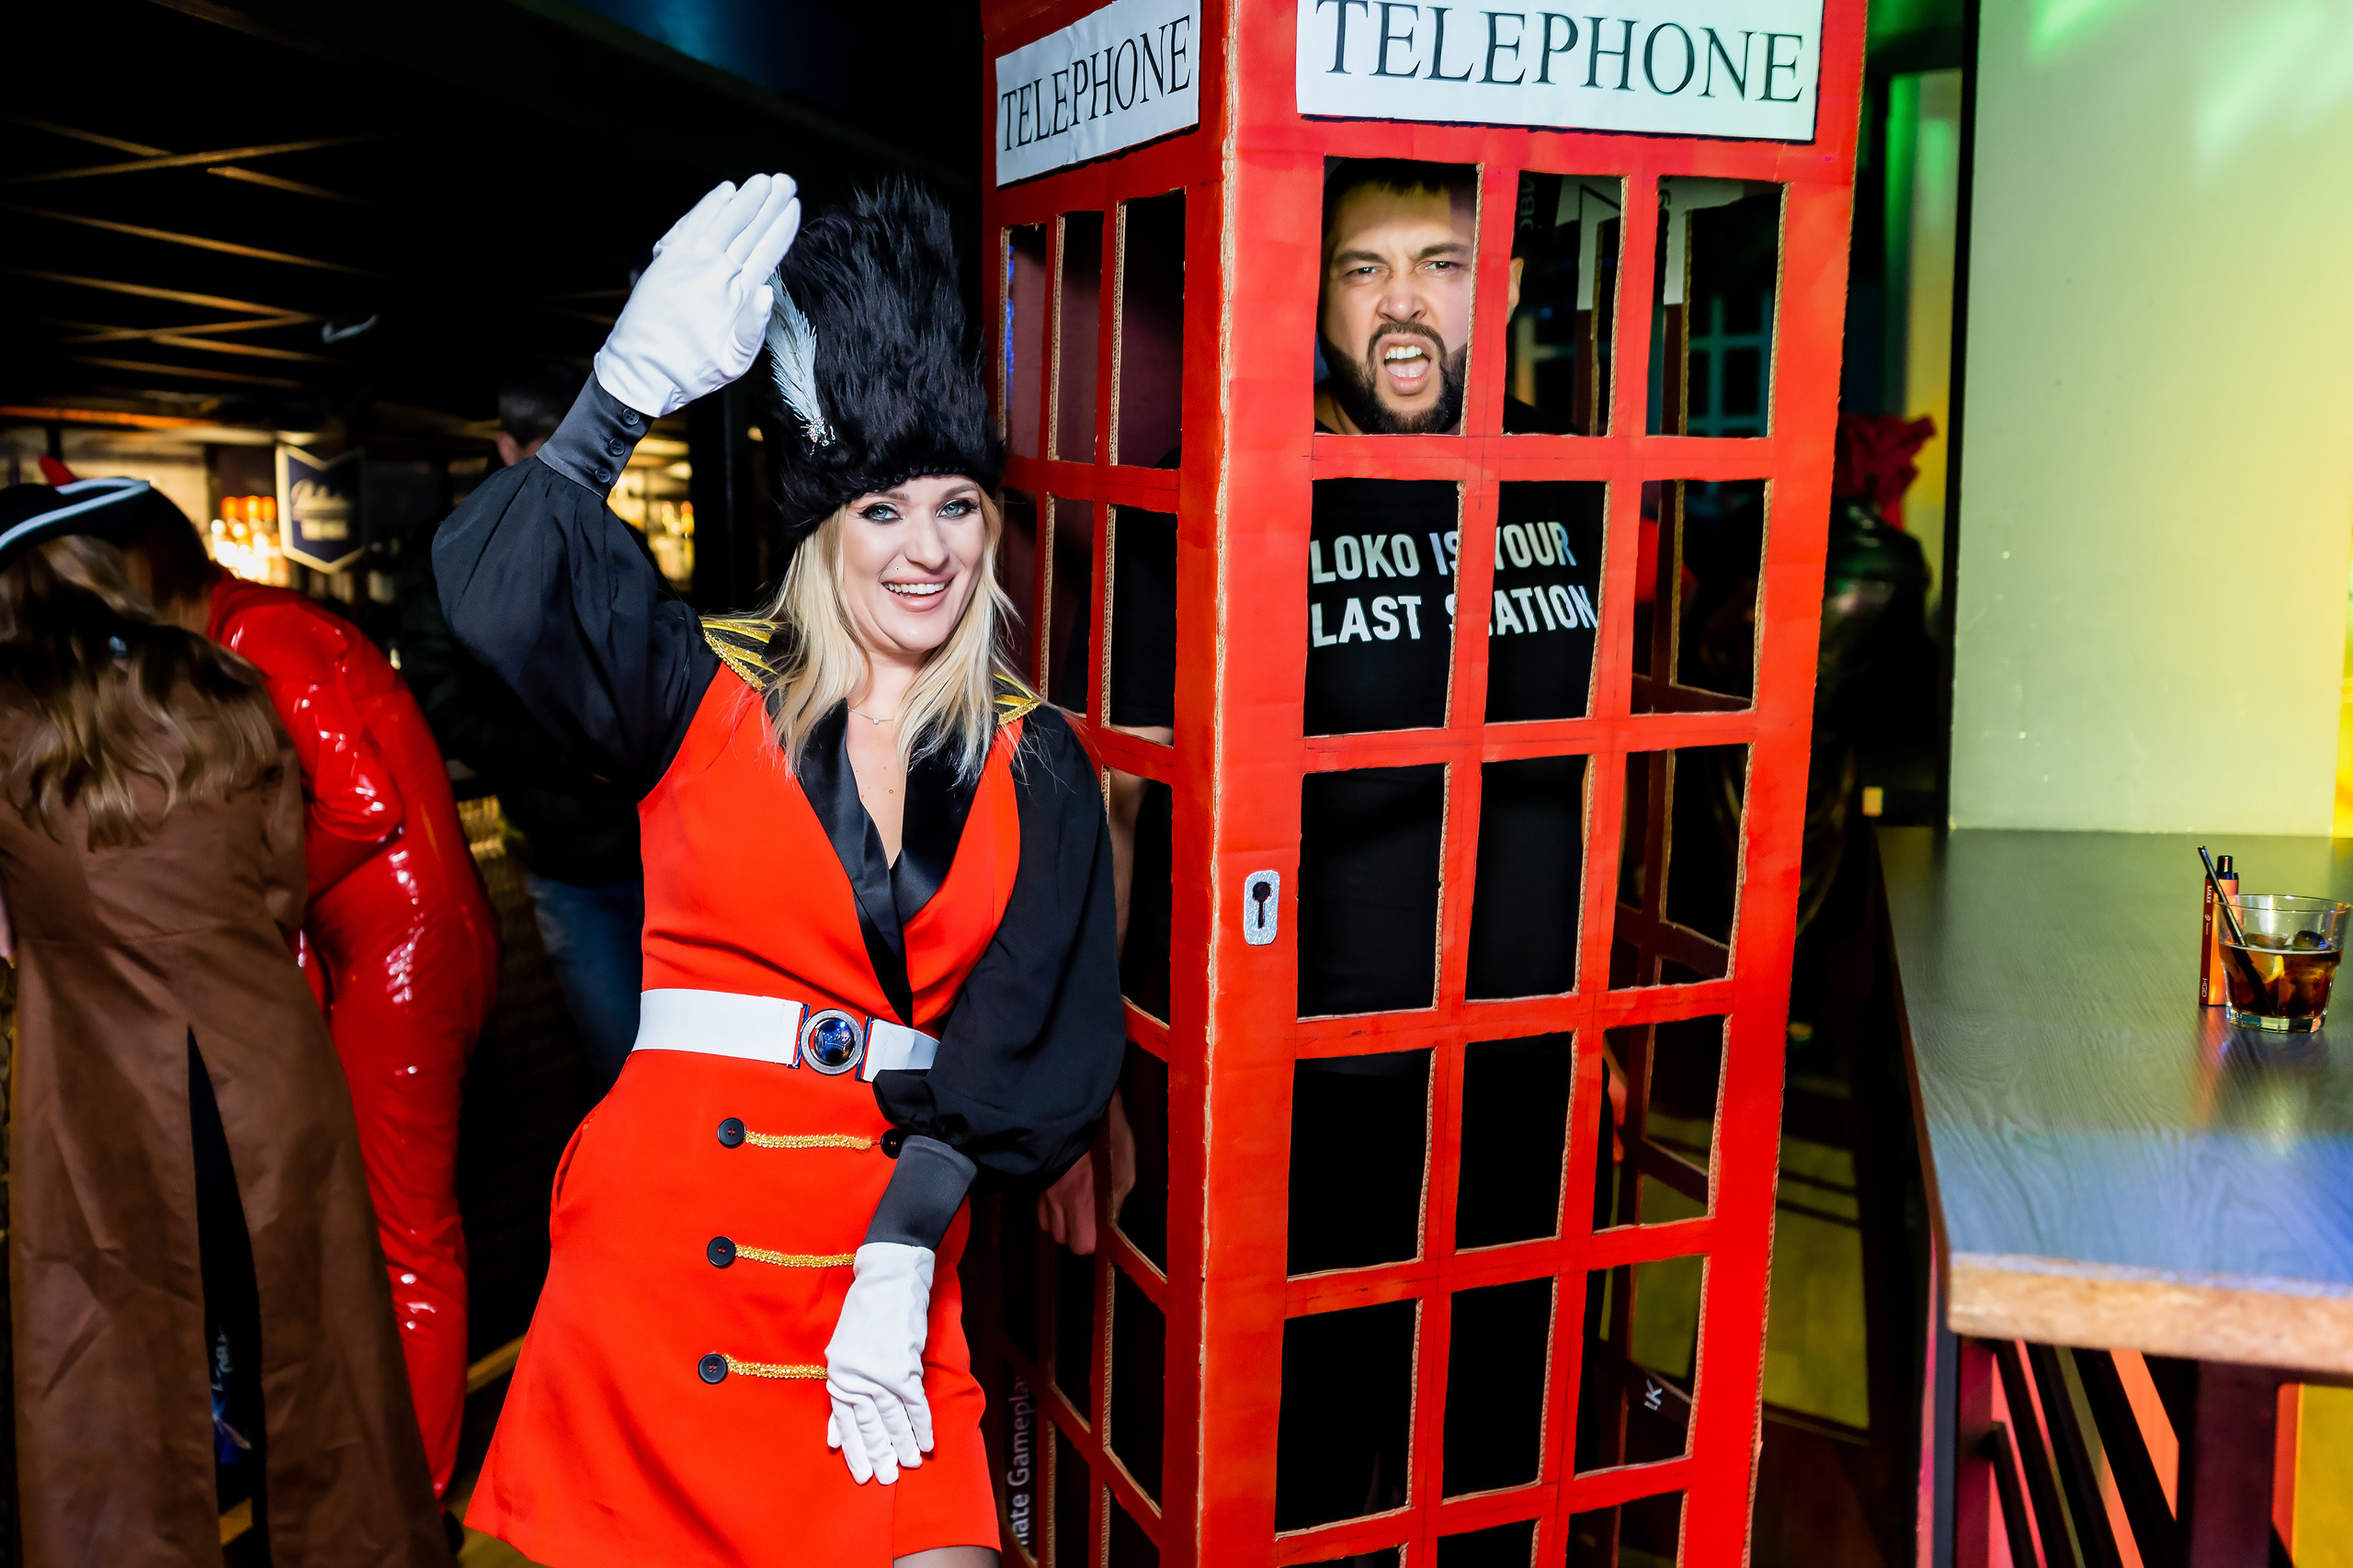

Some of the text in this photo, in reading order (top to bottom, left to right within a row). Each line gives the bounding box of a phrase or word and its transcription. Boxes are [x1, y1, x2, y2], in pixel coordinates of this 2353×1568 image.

[1001, 15, 1191, 152] TELEPHONE
[1315, 0, 1803, 104] TELEPHONE
[1310, 533, 1421, 585] LOKO
[1311, 585, 1598, 648] LAST ATION
[1006, 1376, 1037, 1487] Gamepla
